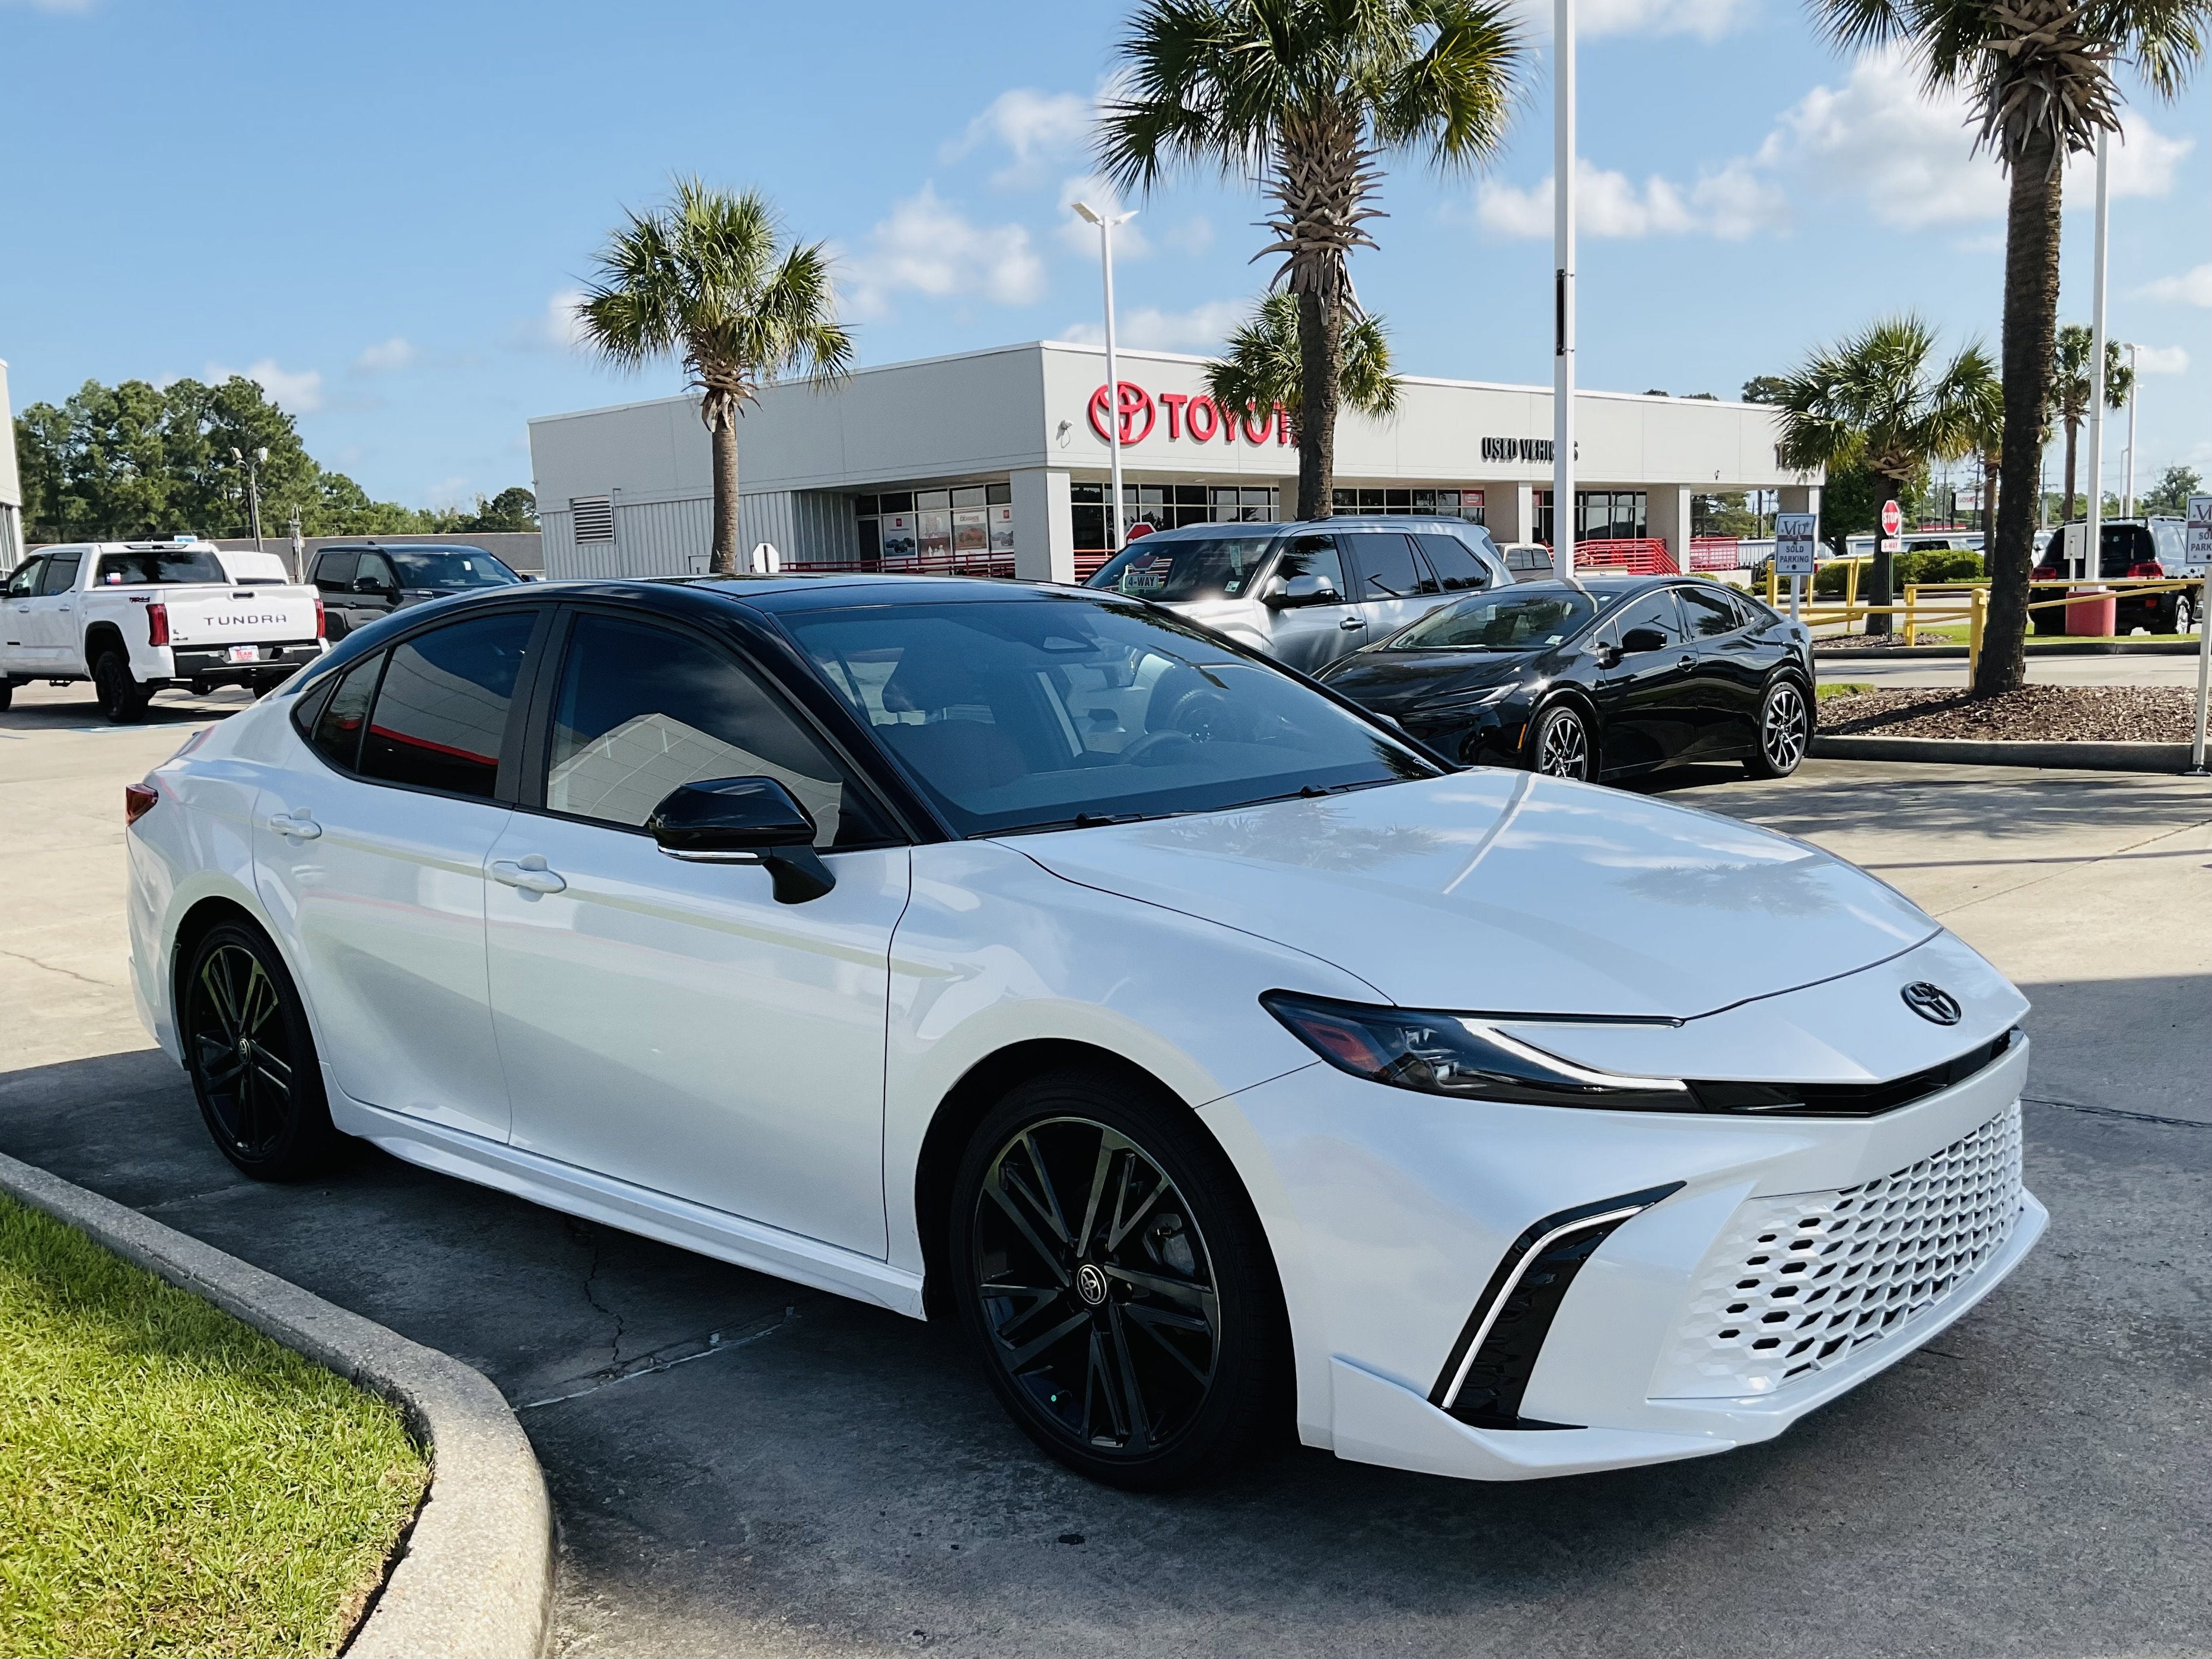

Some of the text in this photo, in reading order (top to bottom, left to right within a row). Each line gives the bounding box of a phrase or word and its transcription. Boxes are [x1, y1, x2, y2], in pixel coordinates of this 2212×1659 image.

[1160, 393, 1298, 445] TOYOT
[1482, 437, 1518, 459] USED
[1883, 512, 1898, 524] STOP
[1128, 577, 1154, 586] 4-WAY
[203, 614, 286, 625] TUNDRA
